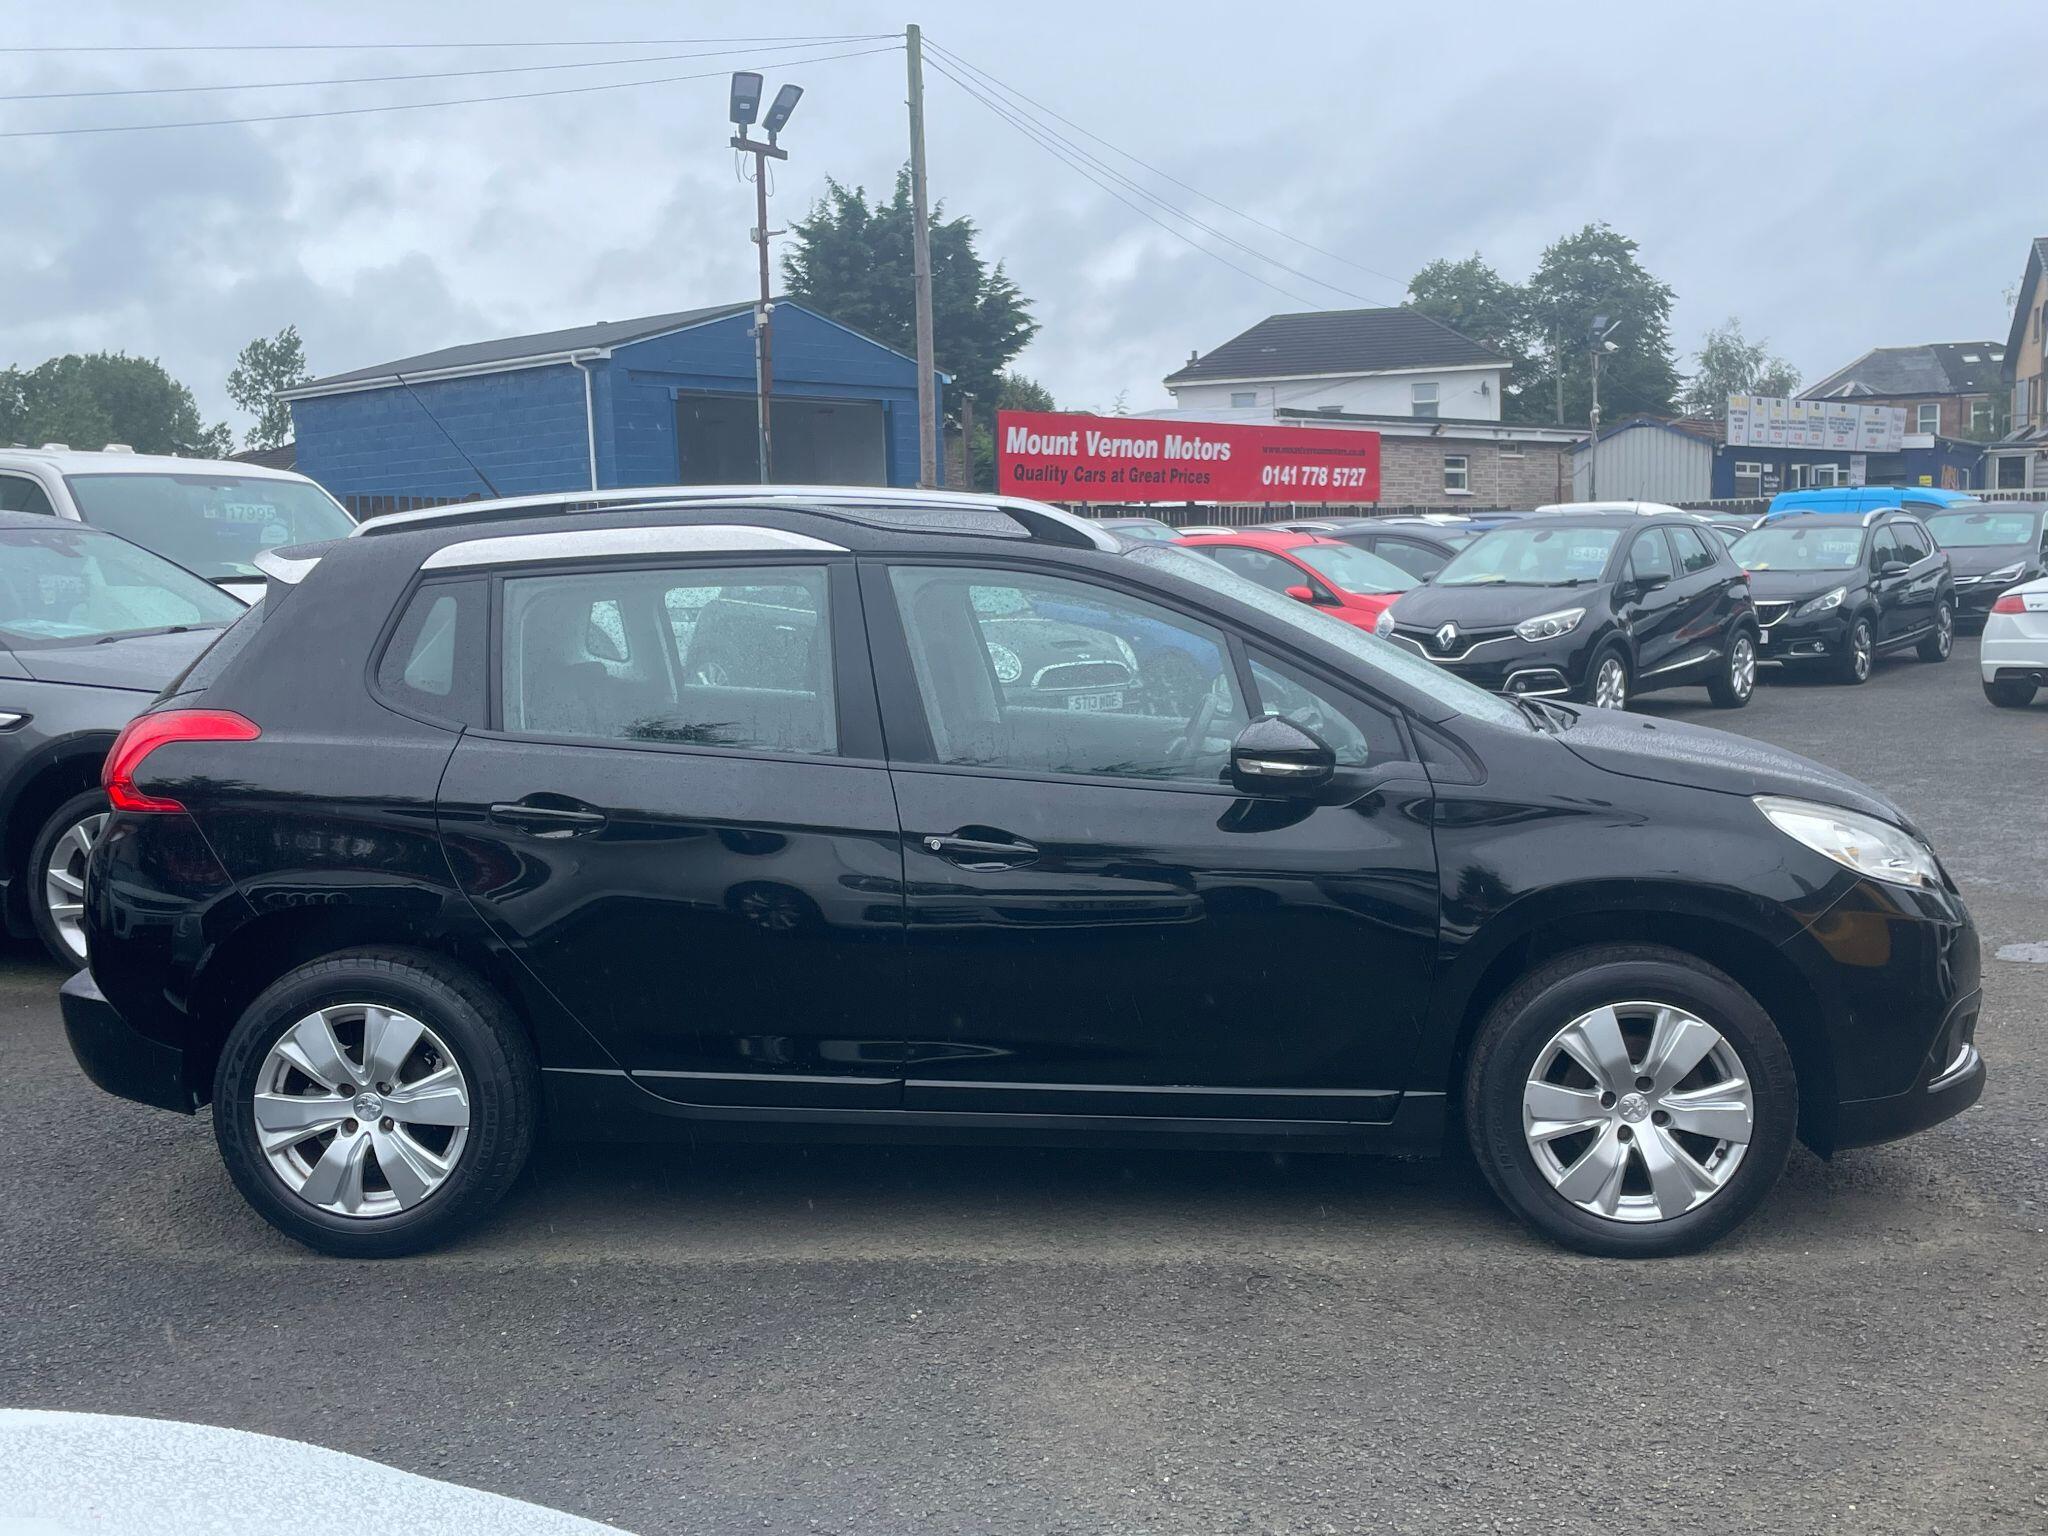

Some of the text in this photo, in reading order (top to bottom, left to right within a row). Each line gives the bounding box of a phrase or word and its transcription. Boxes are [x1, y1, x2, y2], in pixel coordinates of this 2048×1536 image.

[1006, 426, 1231, 461] Mount Vernon Motors
[1014, 463, 1211, 485] Quality Cars at Great Prices
[1262, 465, 1366, 487] 0141 778 5727
